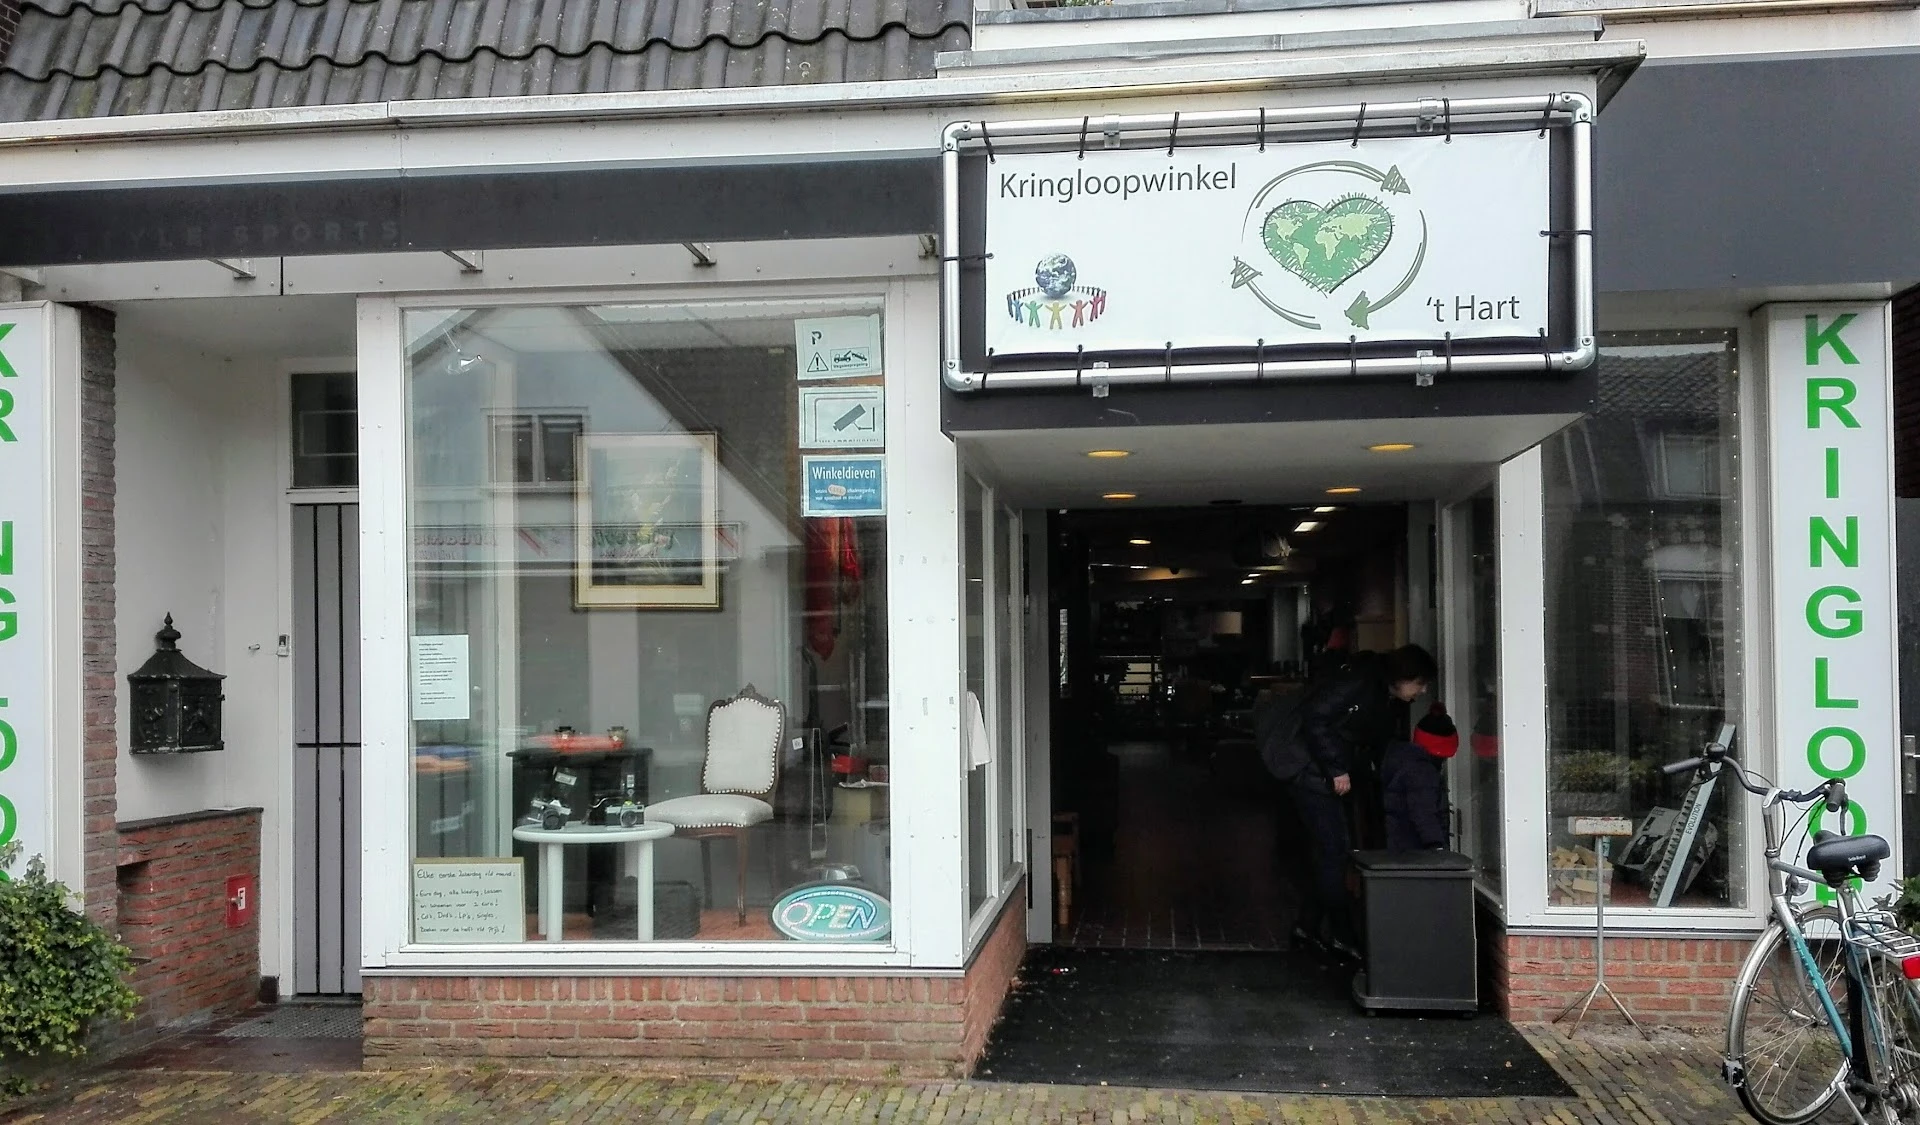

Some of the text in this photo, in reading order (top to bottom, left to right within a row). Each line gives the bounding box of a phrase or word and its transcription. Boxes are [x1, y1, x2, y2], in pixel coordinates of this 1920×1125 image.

[1000, 162, 1236, 203] Kringloopwinkel
[234, 220, 399, 246] SPORTS
[1455, 295, 1520, 321] Hart
[812, 466, 876, 480] Winkeldieven
[1685, 802, 1702, 835] EVOLUTION
[781, 902, 877, 930] OPEN
